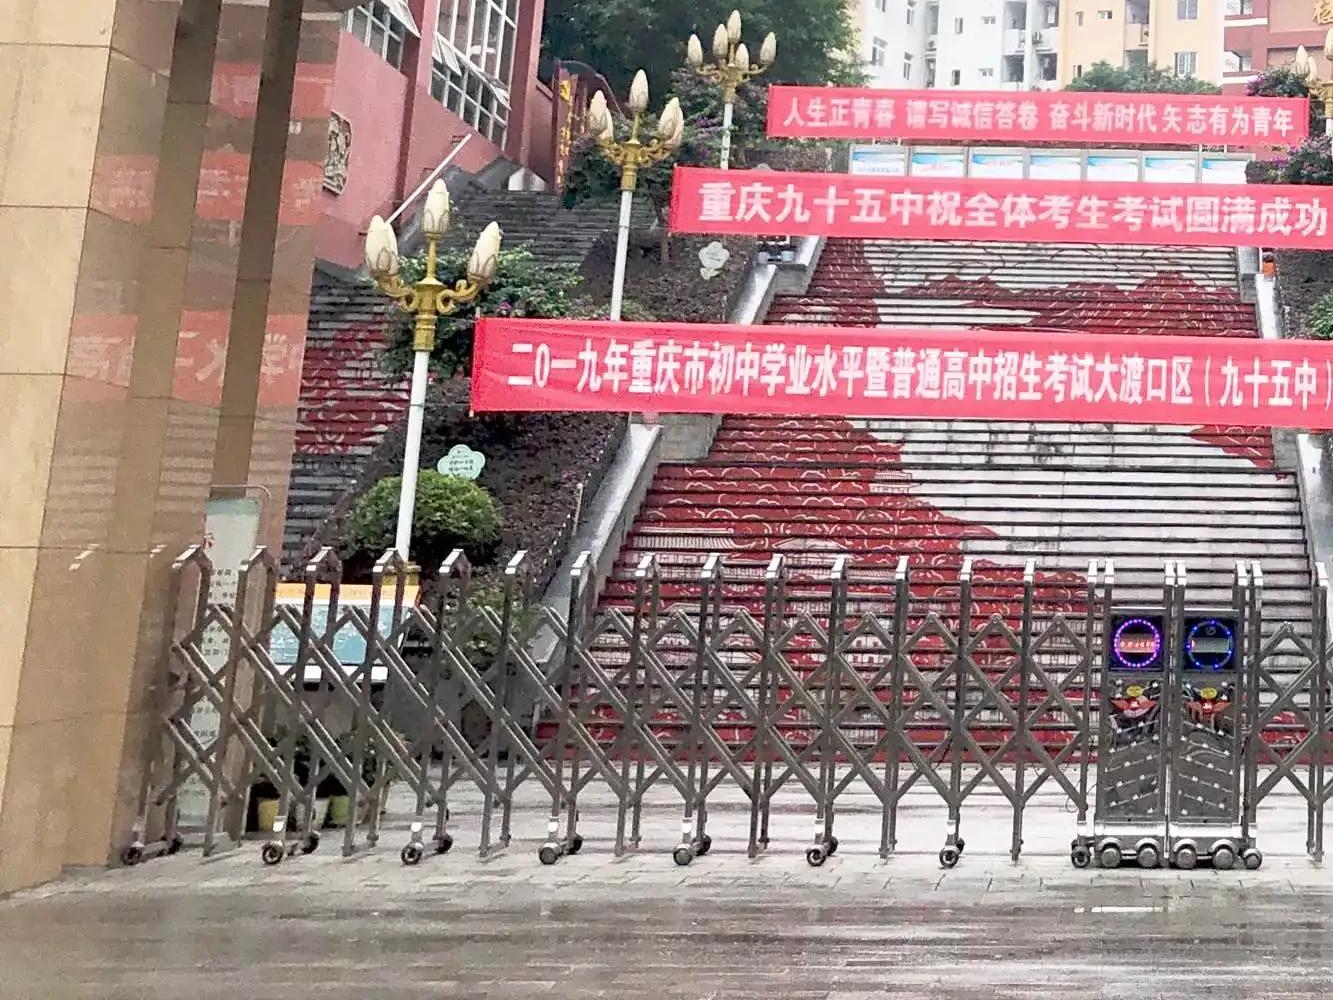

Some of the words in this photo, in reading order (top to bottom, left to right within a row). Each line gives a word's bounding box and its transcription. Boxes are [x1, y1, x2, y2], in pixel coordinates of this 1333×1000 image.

[783, 96, 895, 129] 人生正青春
[906, 99, 1039, 131] 请写诚信答卷
[698, 182, 1329, 238] 重庆九十五中祝全体考生考试圆满成功
